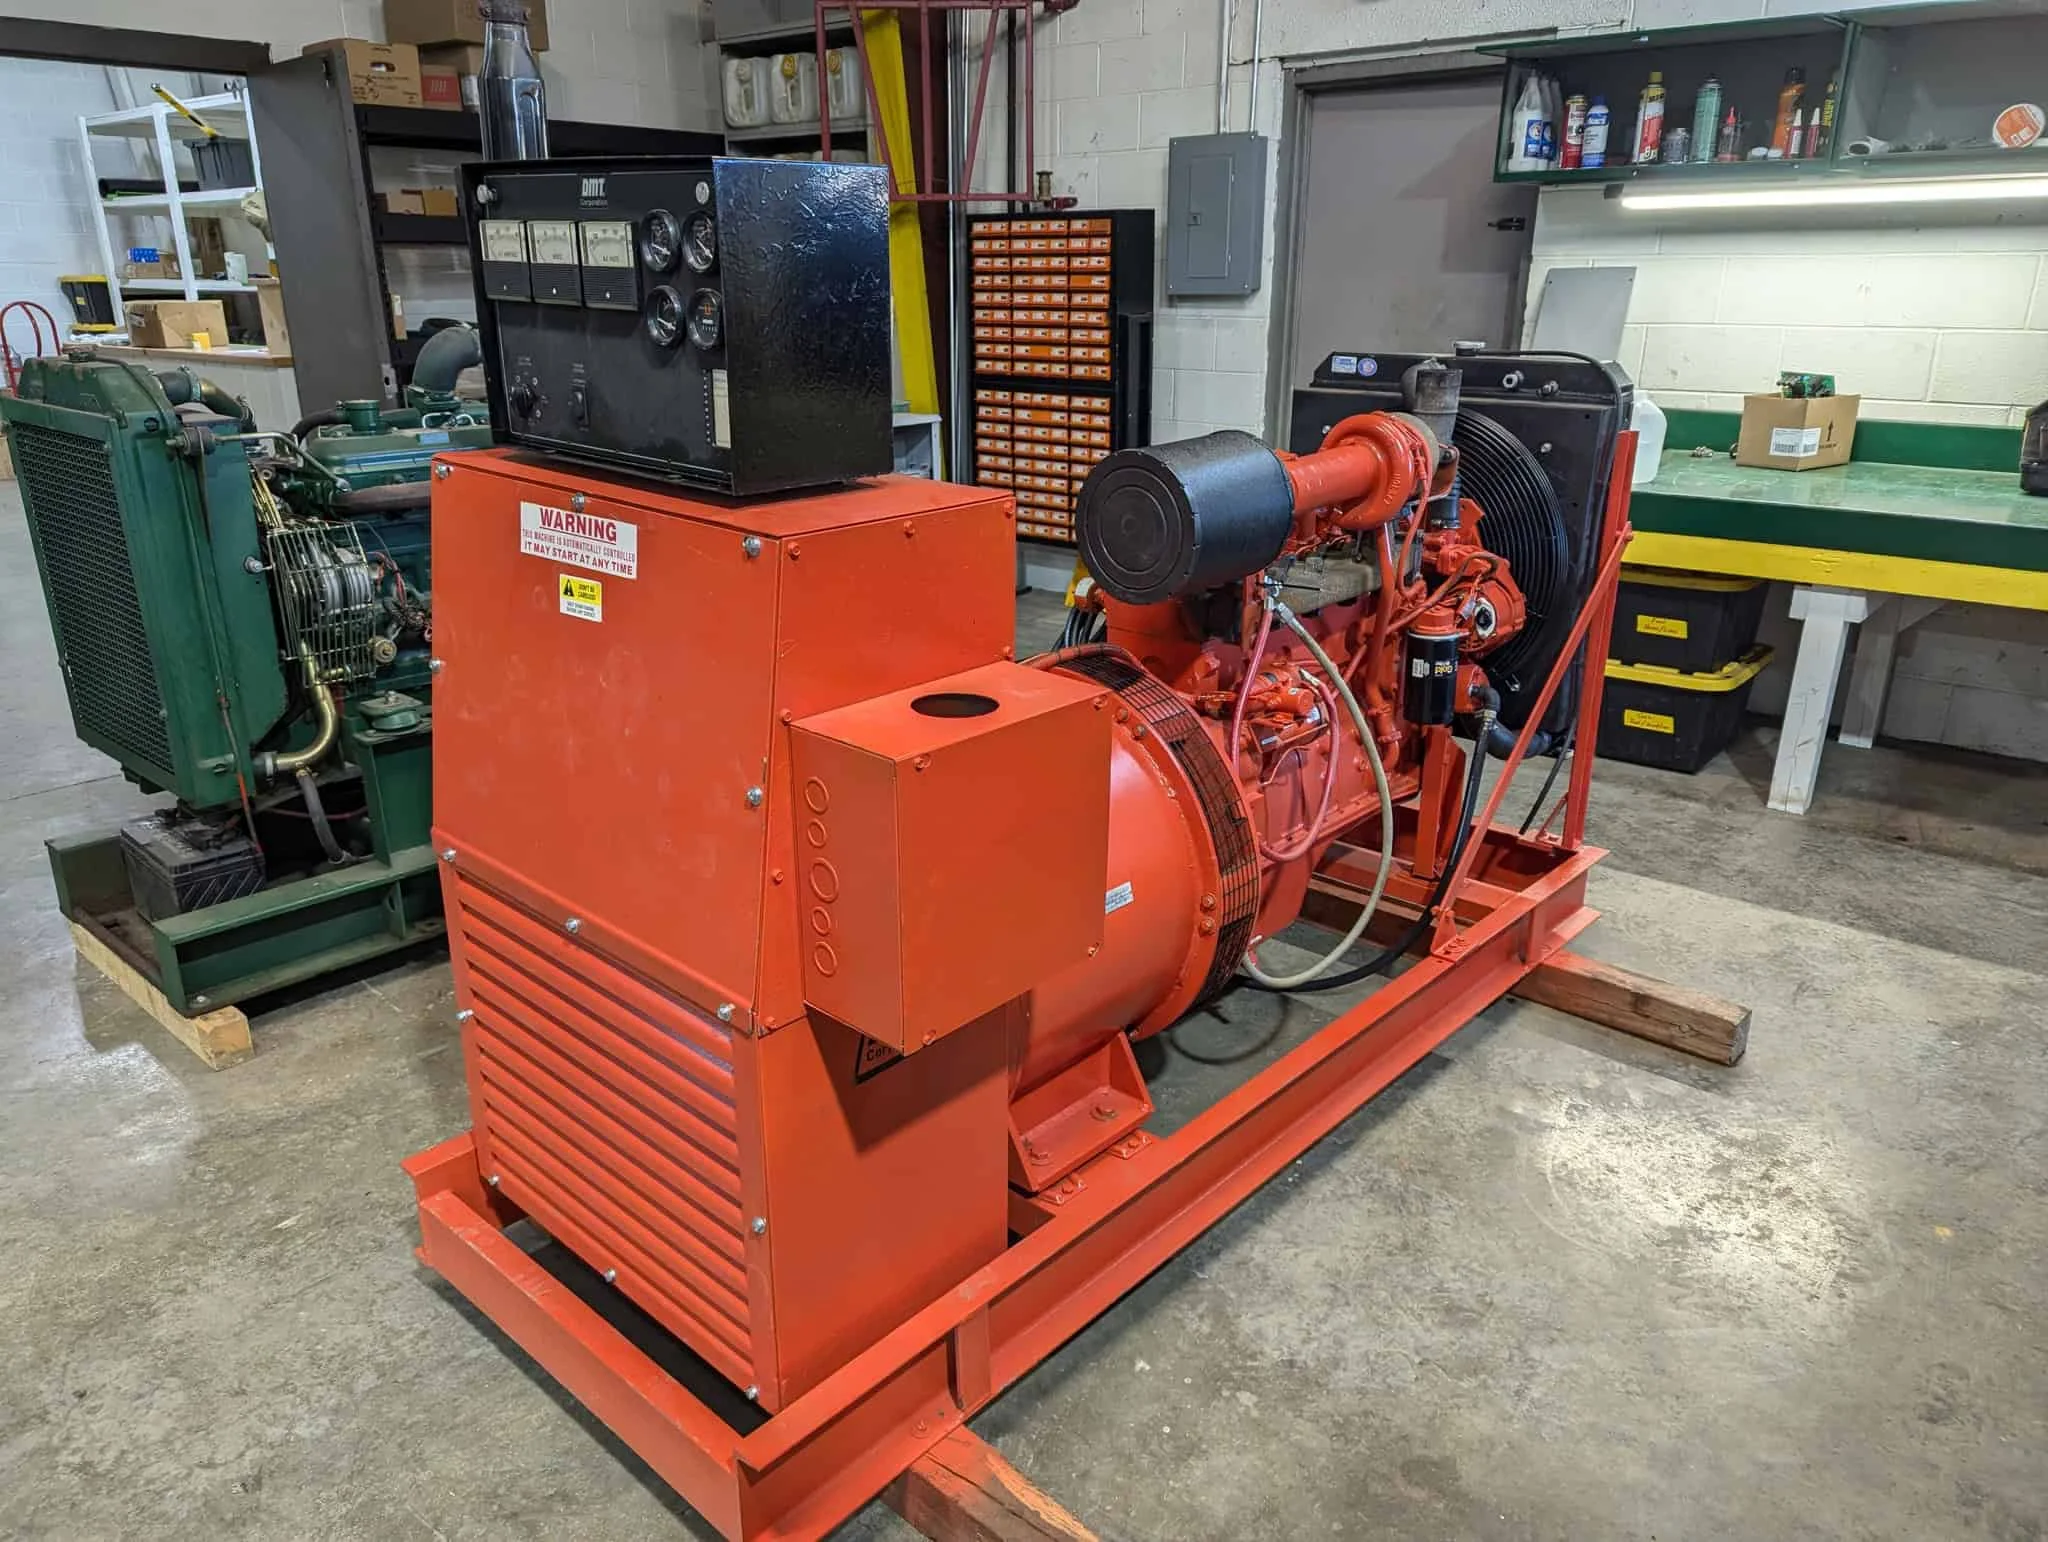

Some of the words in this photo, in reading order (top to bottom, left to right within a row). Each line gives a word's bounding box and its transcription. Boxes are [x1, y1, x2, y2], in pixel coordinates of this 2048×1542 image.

[540, 508, 617, 543] WARNING
[524, 541, 532, 551] IT
[534, 543, 551, 555] MAY
[552, 547, 577, 562] START
[580, 553, 591, 565] AT
[592, 558, 610, 570] ANY
[611, 561, 633, 575] TIME
[534, 530, 555, 544] MACHINE
[556, 535, 562, 545] IS
[563, 537, 602, 555] AUTOMATICALLY
[603, 547, 635, 563] CONTROLLED
